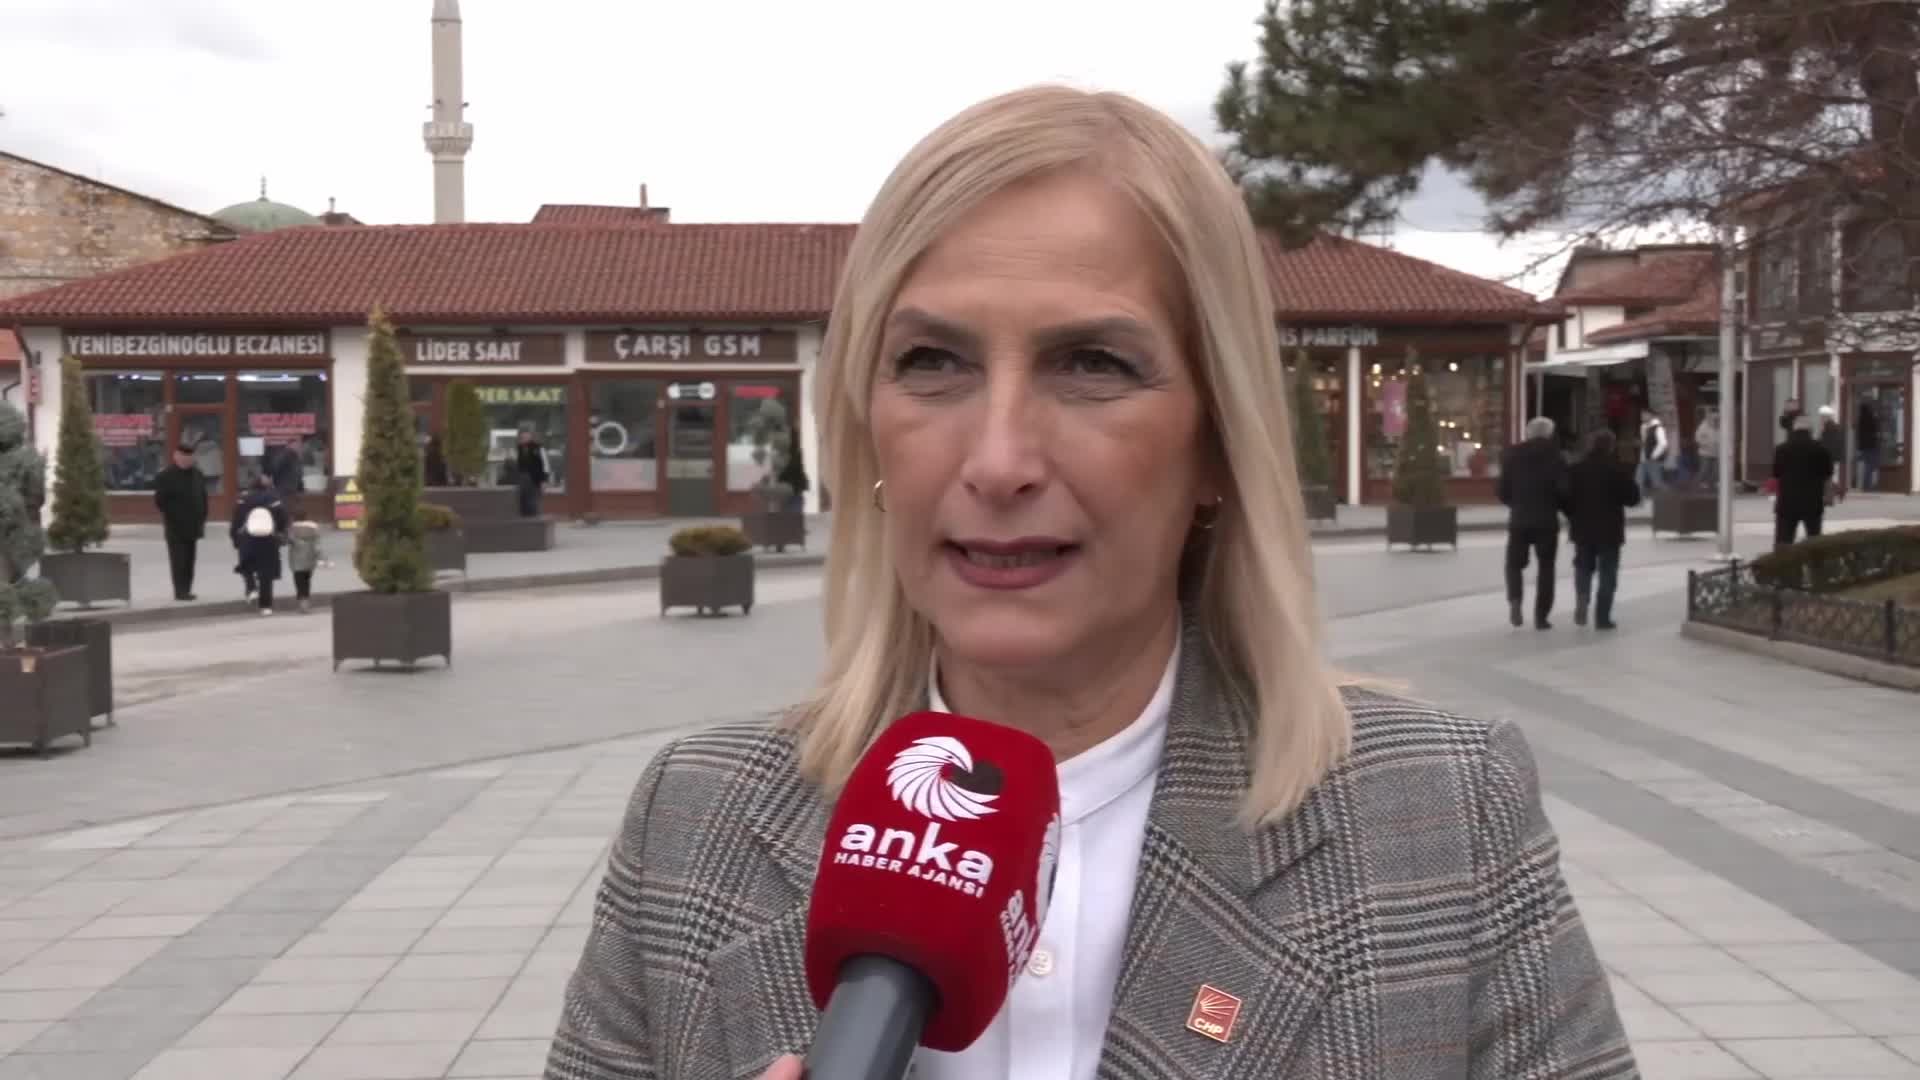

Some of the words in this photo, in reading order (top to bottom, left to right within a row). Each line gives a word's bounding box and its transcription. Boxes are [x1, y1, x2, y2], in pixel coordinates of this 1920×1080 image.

[67, 333, 230, 356] YENİBEZGİNOĞLU
[235, 333, 325, 355] ECZANESİ
[416, 338, 470, 361] LİDER
[474, 341, 522, 361] SAAT
[614, 333, 691, 360] ÇARŞI
[703, 334, 761, 357] GSM
[513, 386, 562, 404] SAAT
[840, 822, 993, 885] anka
[834, 852, 901, 873] HABER
[907, 863, 984, 898] AJANSI
[1194, 1017, 1225, 1034] CHP
